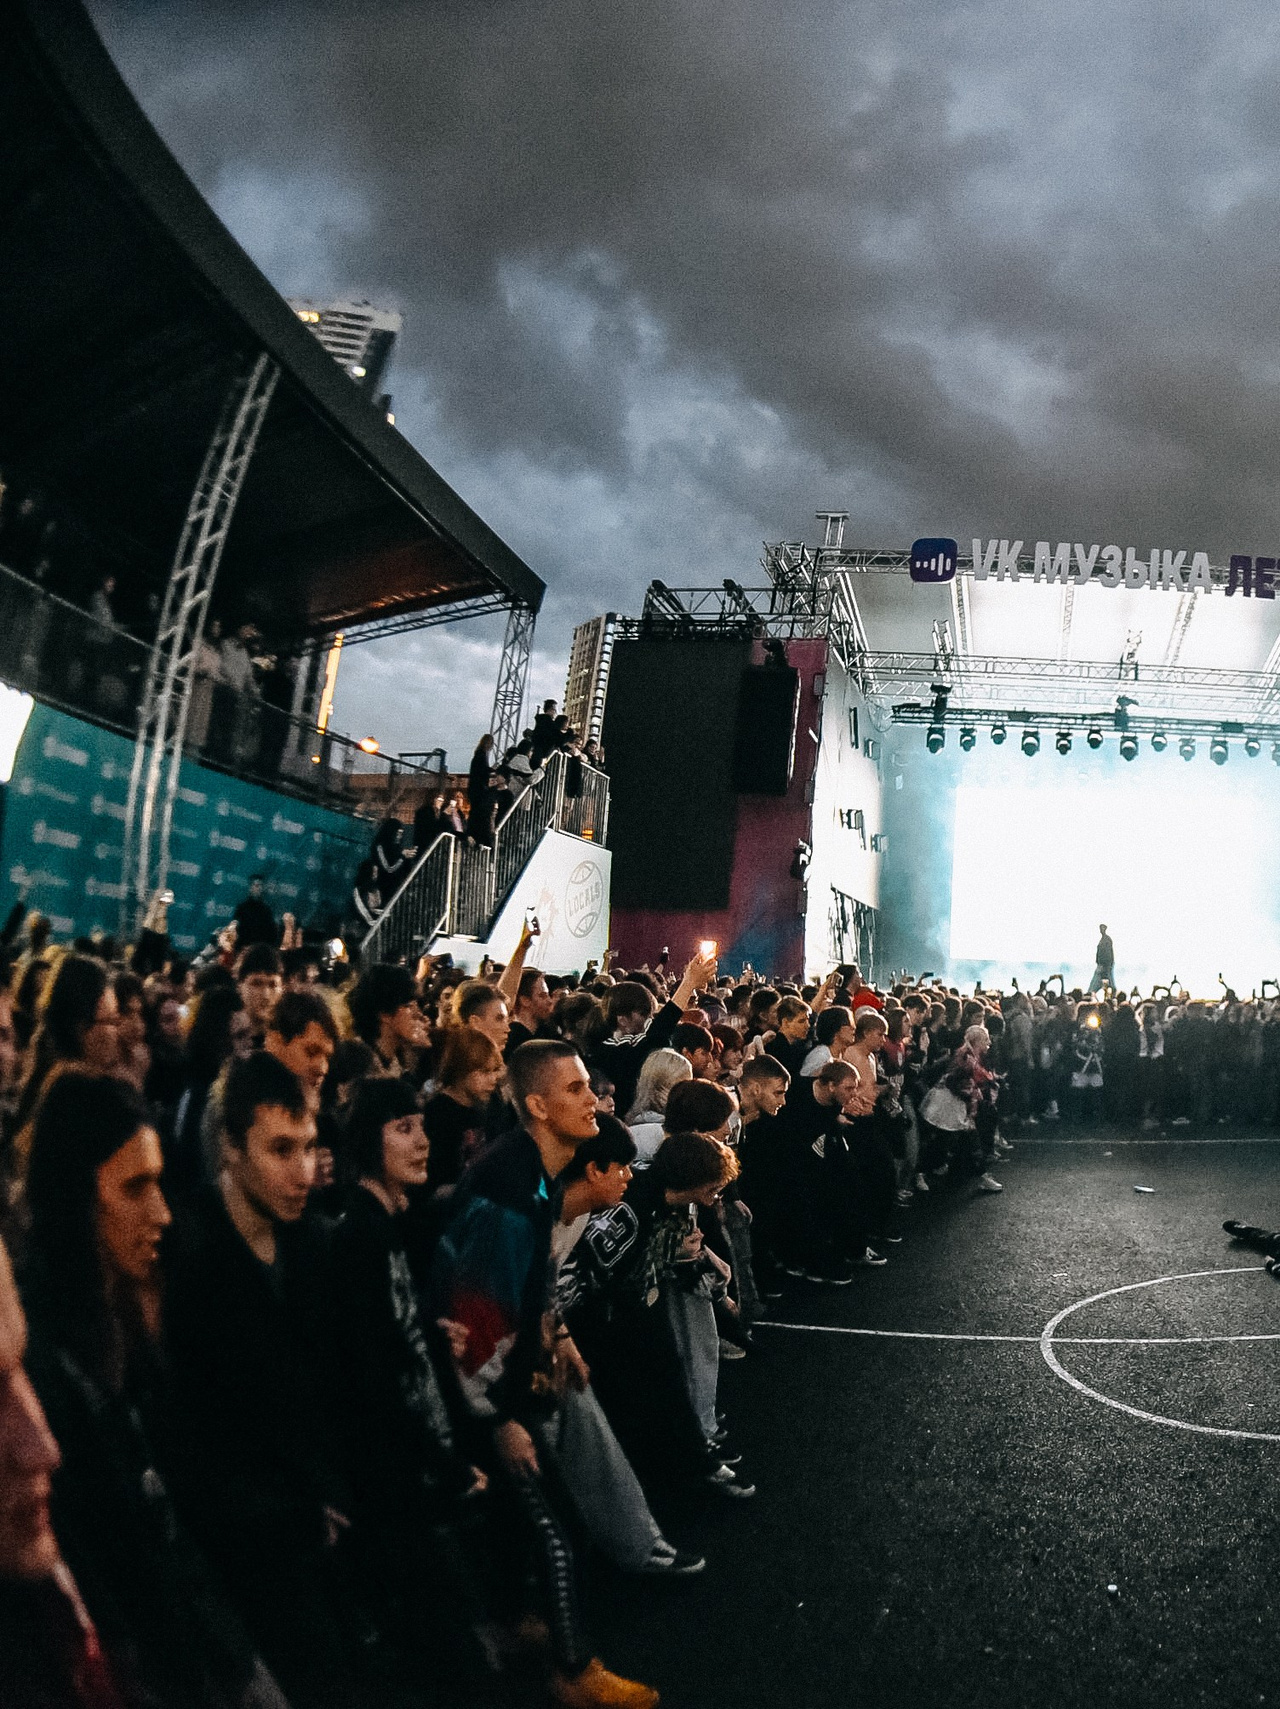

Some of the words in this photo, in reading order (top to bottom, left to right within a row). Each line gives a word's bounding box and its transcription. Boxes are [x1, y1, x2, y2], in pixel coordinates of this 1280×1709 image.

[972, 538, 1024, 582] VK
[1033, 541, 1212, 594] МУЗЫКА
[568, 881, 601, 917] LOCALS
